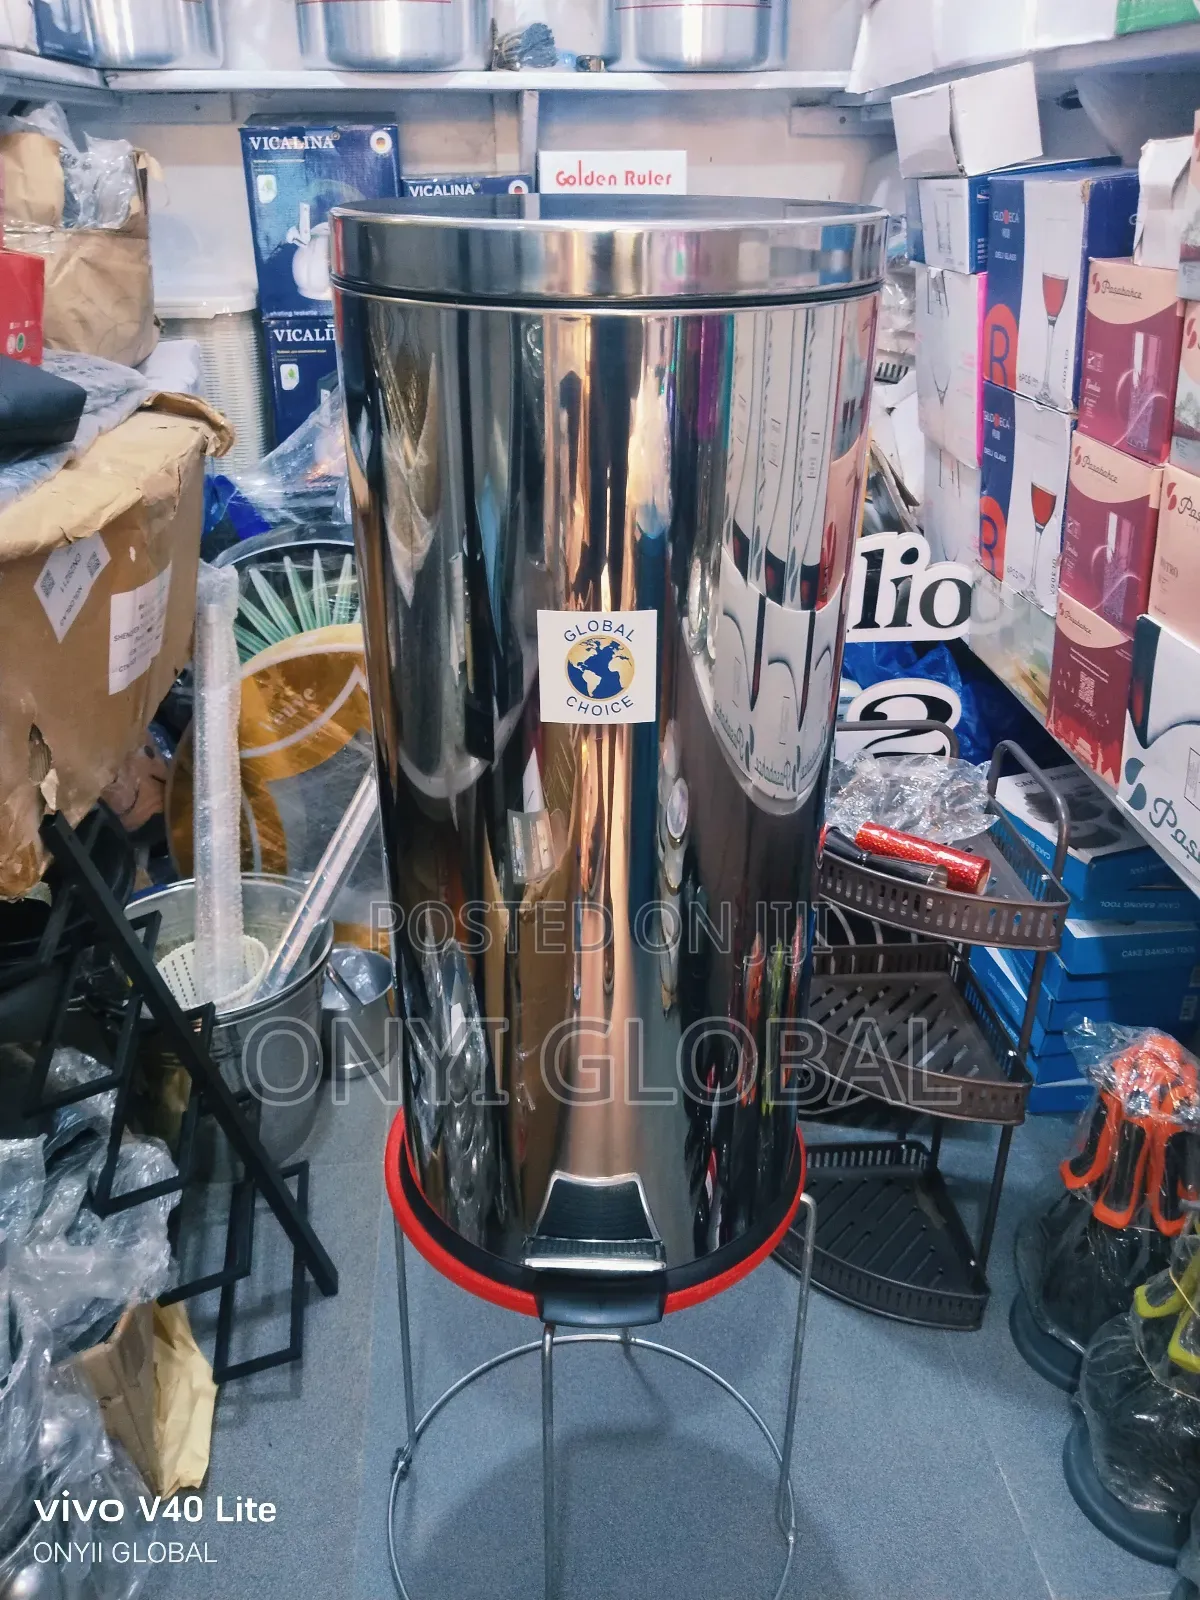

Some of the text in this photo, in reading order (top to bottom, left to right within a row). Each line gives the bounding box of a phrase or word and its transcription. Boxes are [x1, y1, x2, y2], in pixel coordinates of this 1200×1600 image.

[249, 136, 335, 150] VICALINA
[556, 160, 672, 187] Golden Ruler
[409, 183, 475, 198] VICALINA
[273, 328, 336, 342] VICALI
[564, 620, 634, 642] GLOBAL
[566, 695, 634, 716] CHOICE
